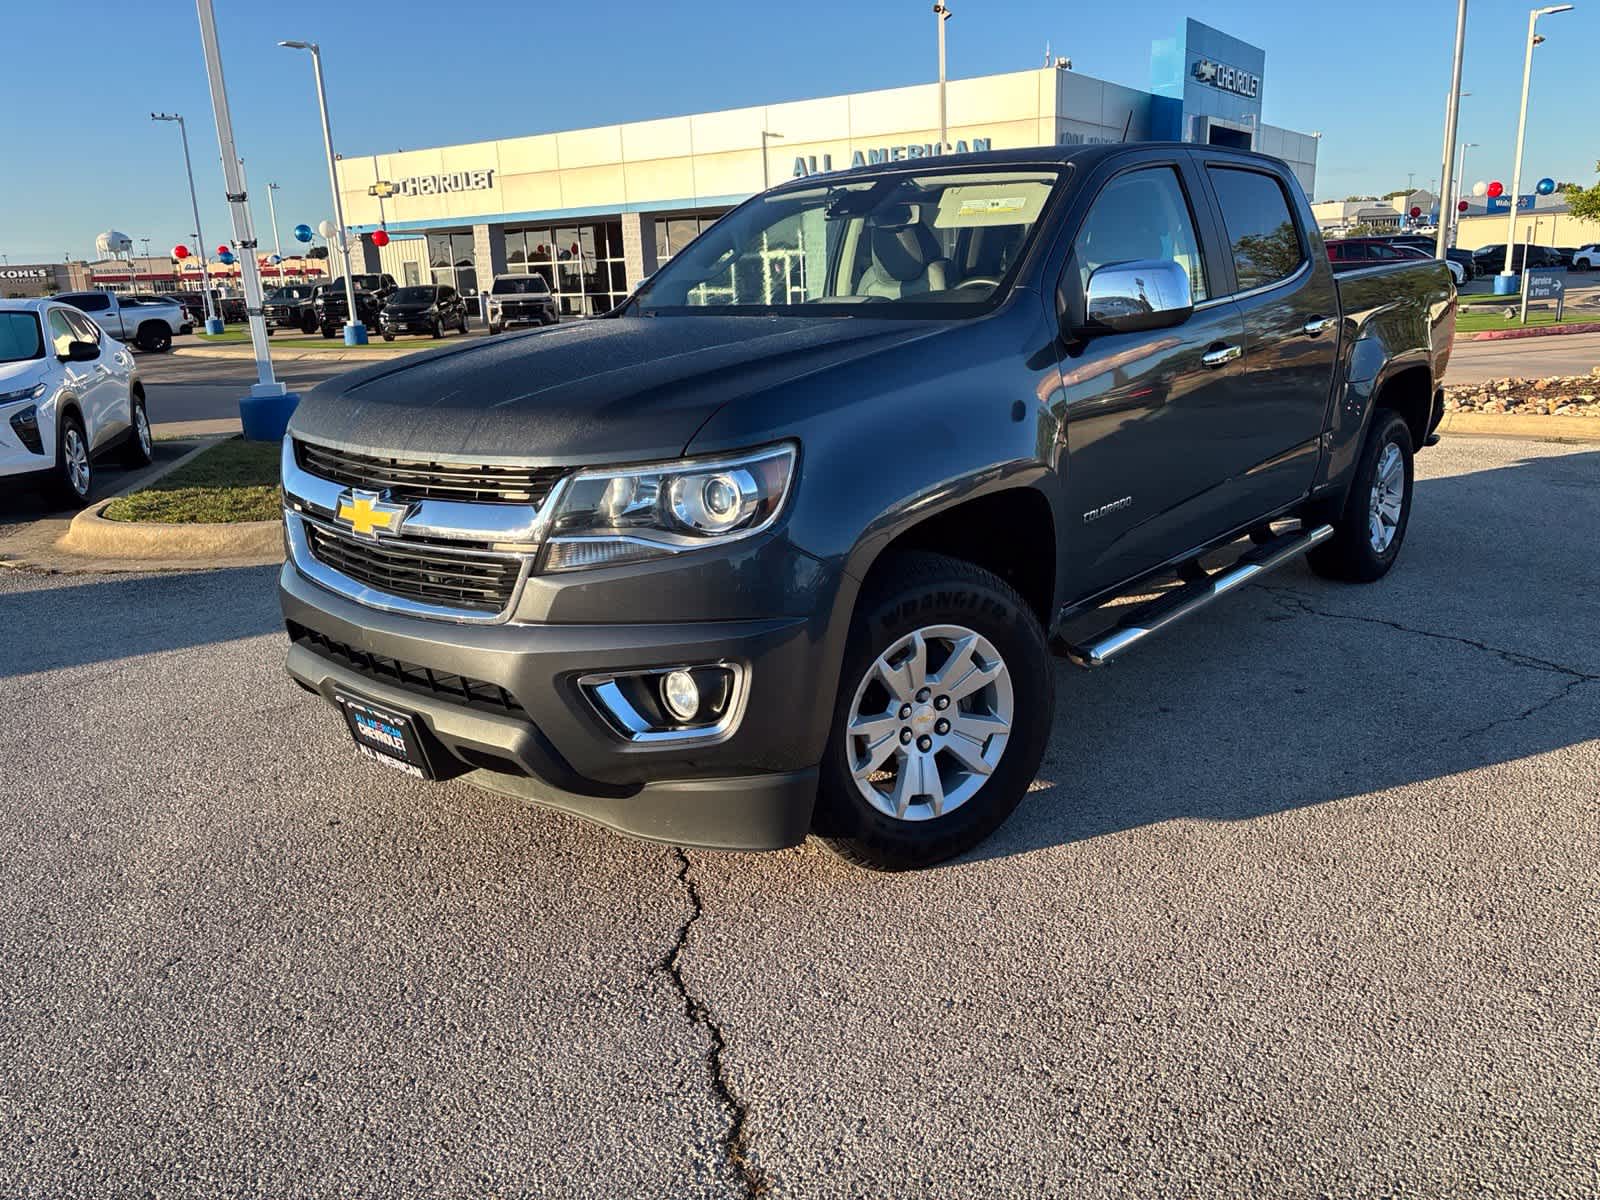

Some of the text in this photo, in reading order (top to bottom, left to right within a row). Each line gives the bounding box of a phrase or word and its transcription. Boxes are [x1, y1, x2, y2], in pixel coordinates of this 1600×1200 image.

[1217, 64, 1260, 97] CHEVROLET
[793, 138, 992, 177] ALL AMERICAN
[399, 169, 495, 197] CHEVROLET
[1531, 276, 1552, 285] Service
[1535, 288, 1550, 296] Parts
[1083, 496, 1132, 521] COLORADO
[355, 713, 366, 725] ALL
[367, 717, 402, 738] AMERICAN
[357, 722, 407, 752] CHEVROLET
